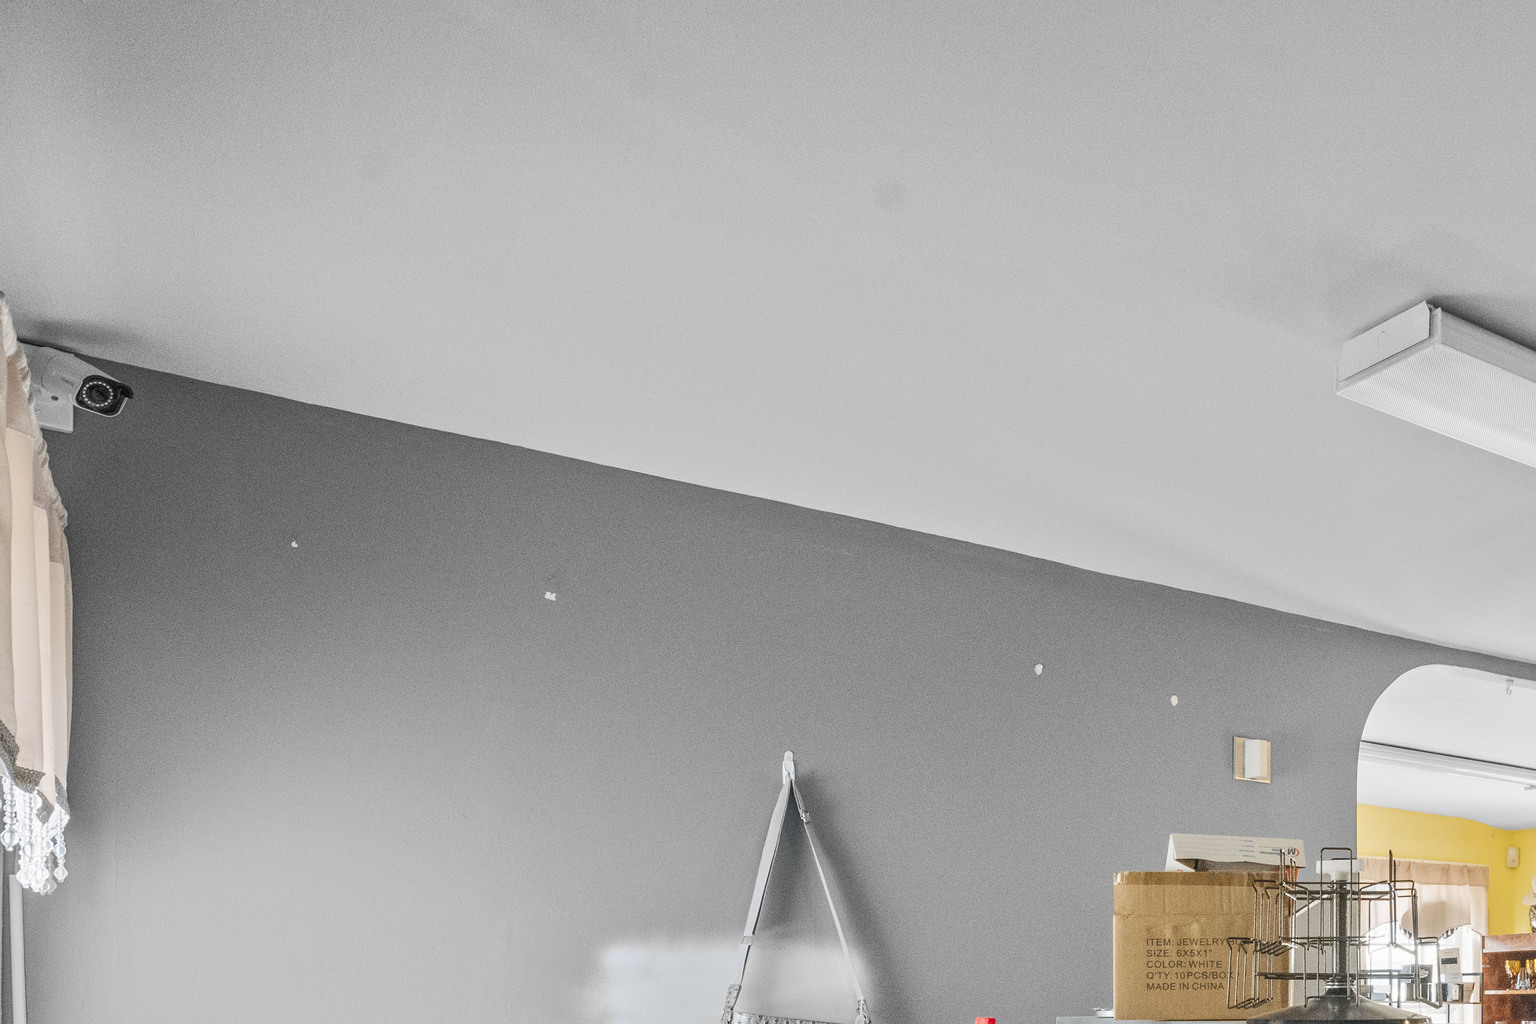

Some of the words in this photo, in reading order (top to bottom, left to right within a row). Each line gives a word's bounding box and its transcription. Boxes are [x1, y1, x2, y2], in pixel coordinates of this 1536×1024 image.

[1146, 938, 1174, 946] ITEM:
[1177, 938, 1225, 946] JEWELRY
[1146, 949, 1172, 957] SIZE:
[1146, 960, 1186, 968] COLOR:
[1188, 960, 1222, 968] WHITE
[1146, 982, 1176, 990] MADE
[1179, 982, 1189, 990] IN
[1192, 982, 1225, 990] CHINA
